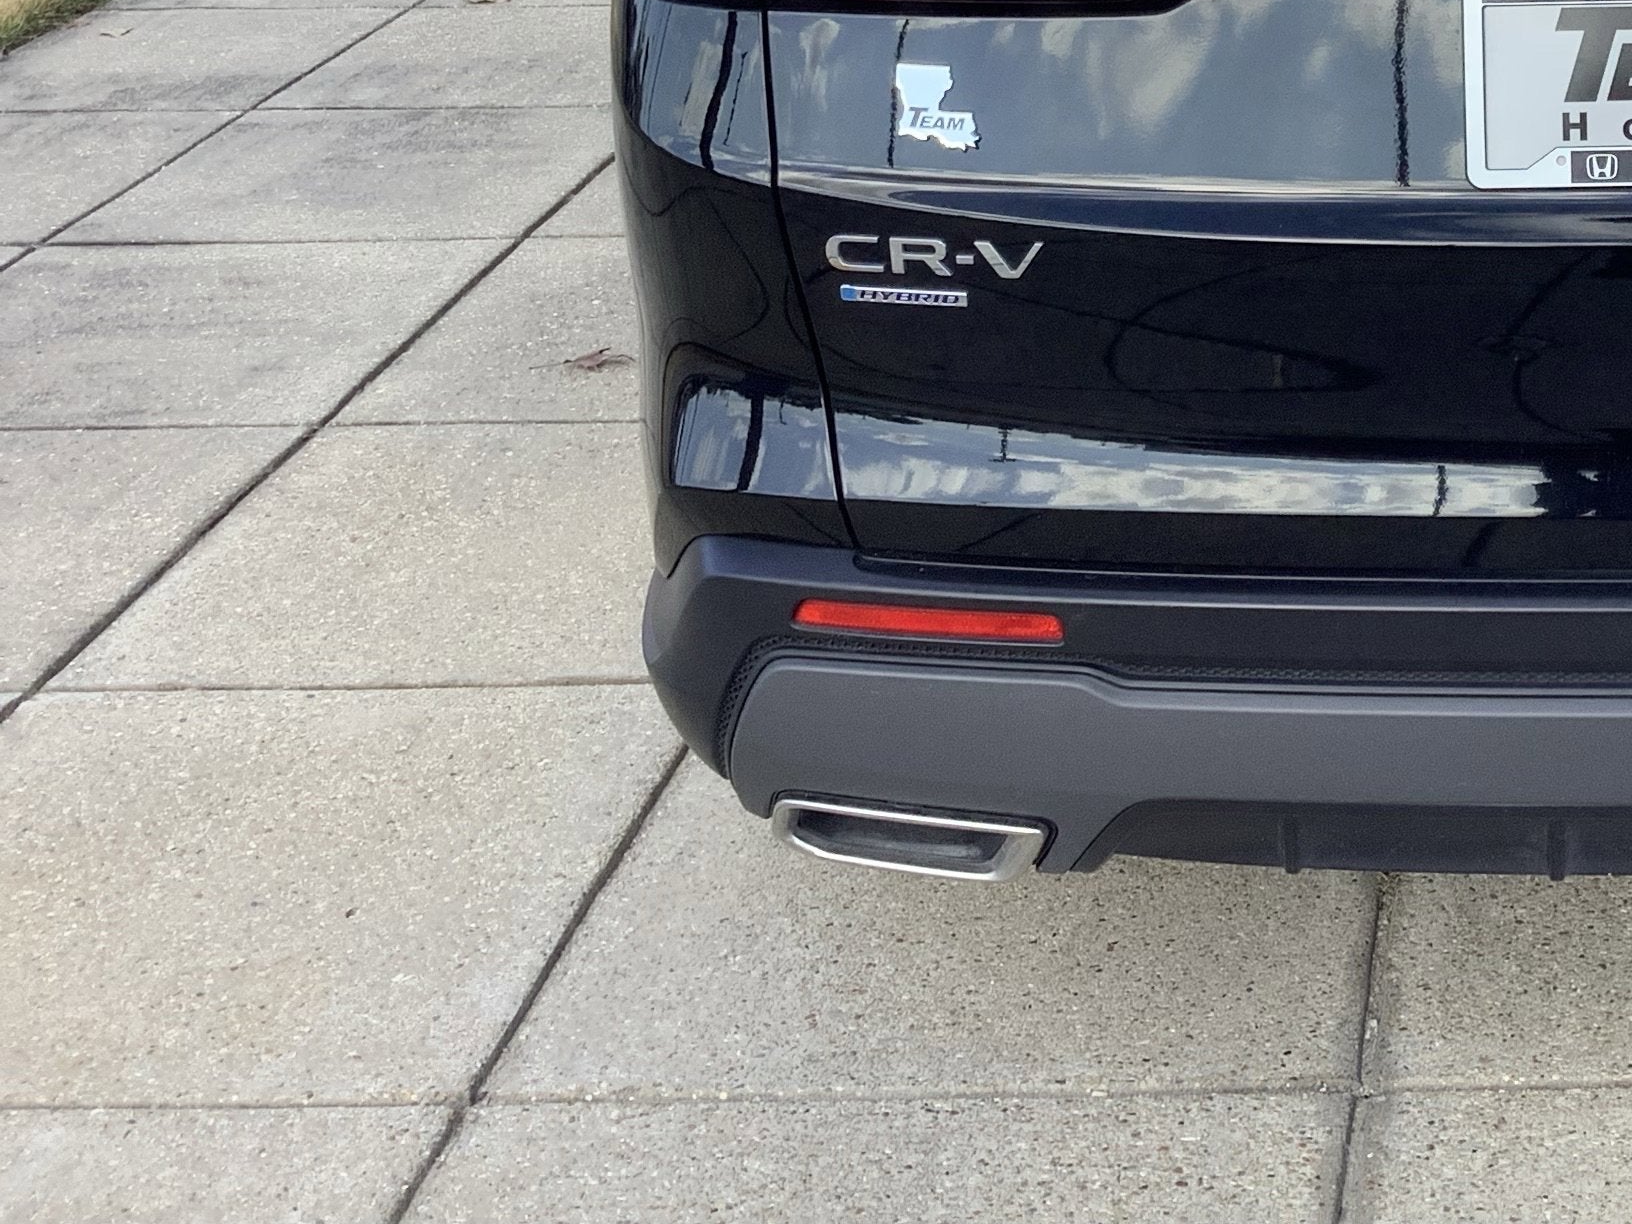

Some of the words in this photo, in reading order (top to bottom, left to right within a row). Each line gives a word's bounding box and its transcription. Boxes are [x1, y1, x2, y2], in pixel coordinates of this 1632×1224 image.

[908, 106, 966, 130] TEAM
[825, 234, 1045, 279] CR-V
[859, 289, 960, 305] HYBRID
